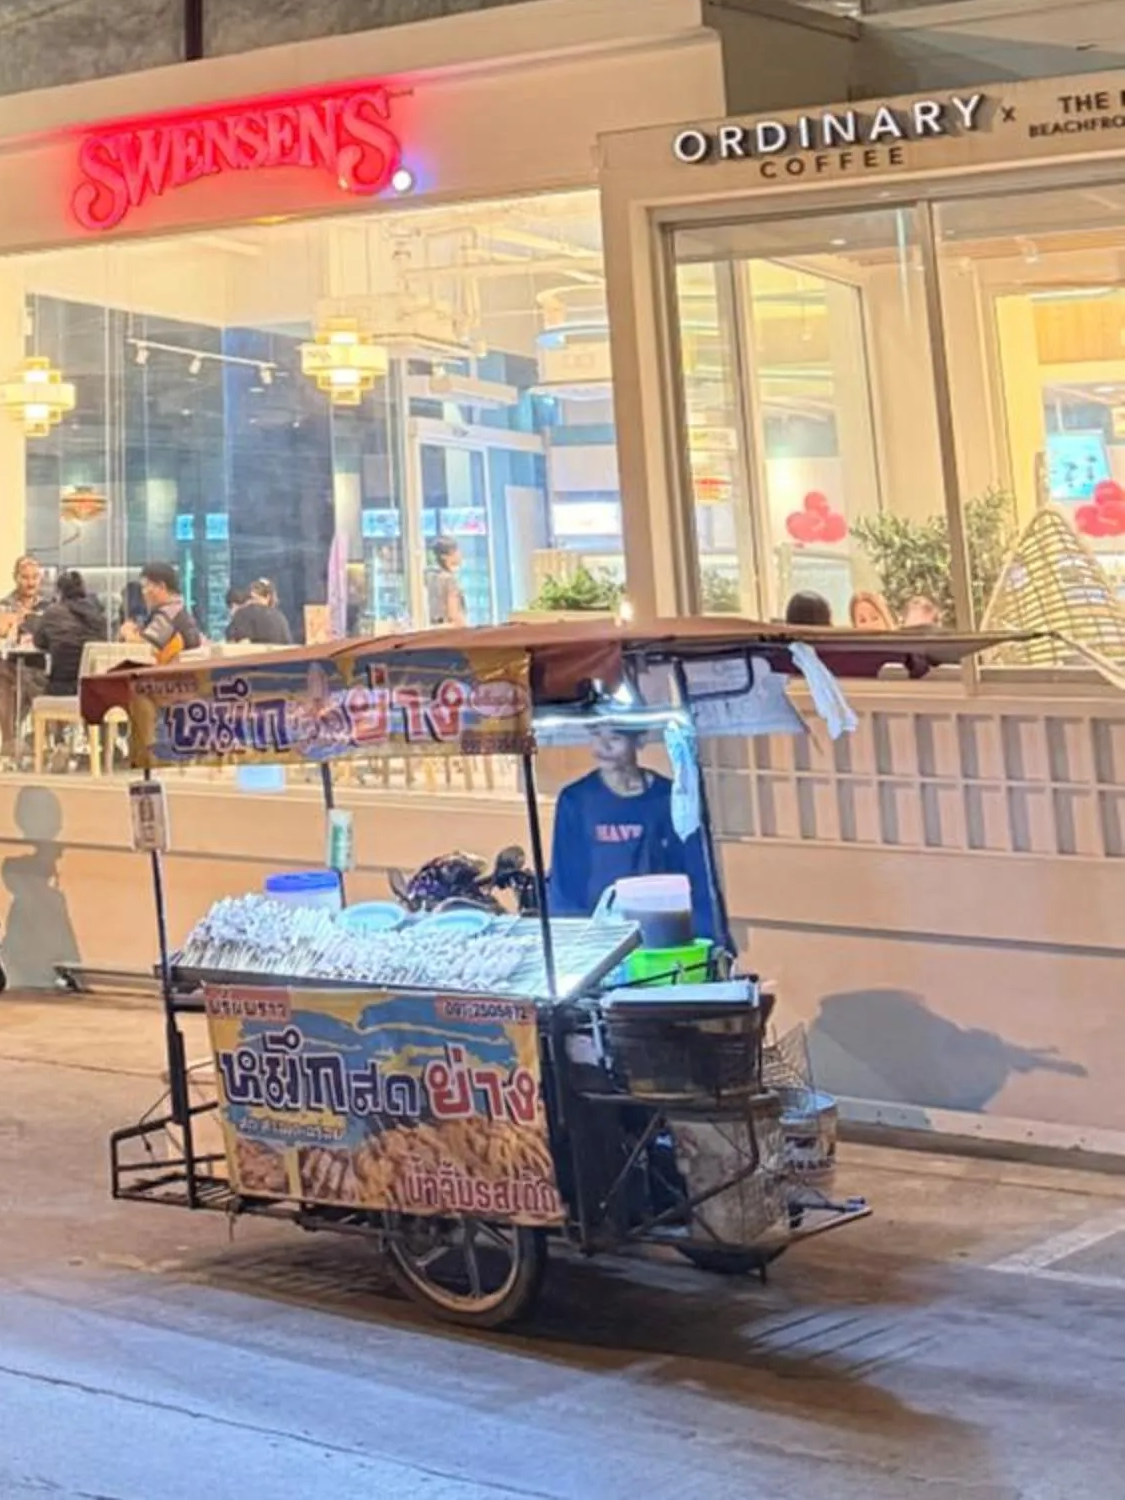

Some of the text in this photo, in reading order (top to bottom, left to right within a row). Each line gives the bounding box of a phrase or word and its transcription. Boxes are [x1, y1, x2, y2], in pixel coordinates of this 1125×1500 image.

[1057, 90, 1111, 114] THE
[673, 93, 985, 163] ORDINARY
[759, 146, 905, 179] COFFEE
